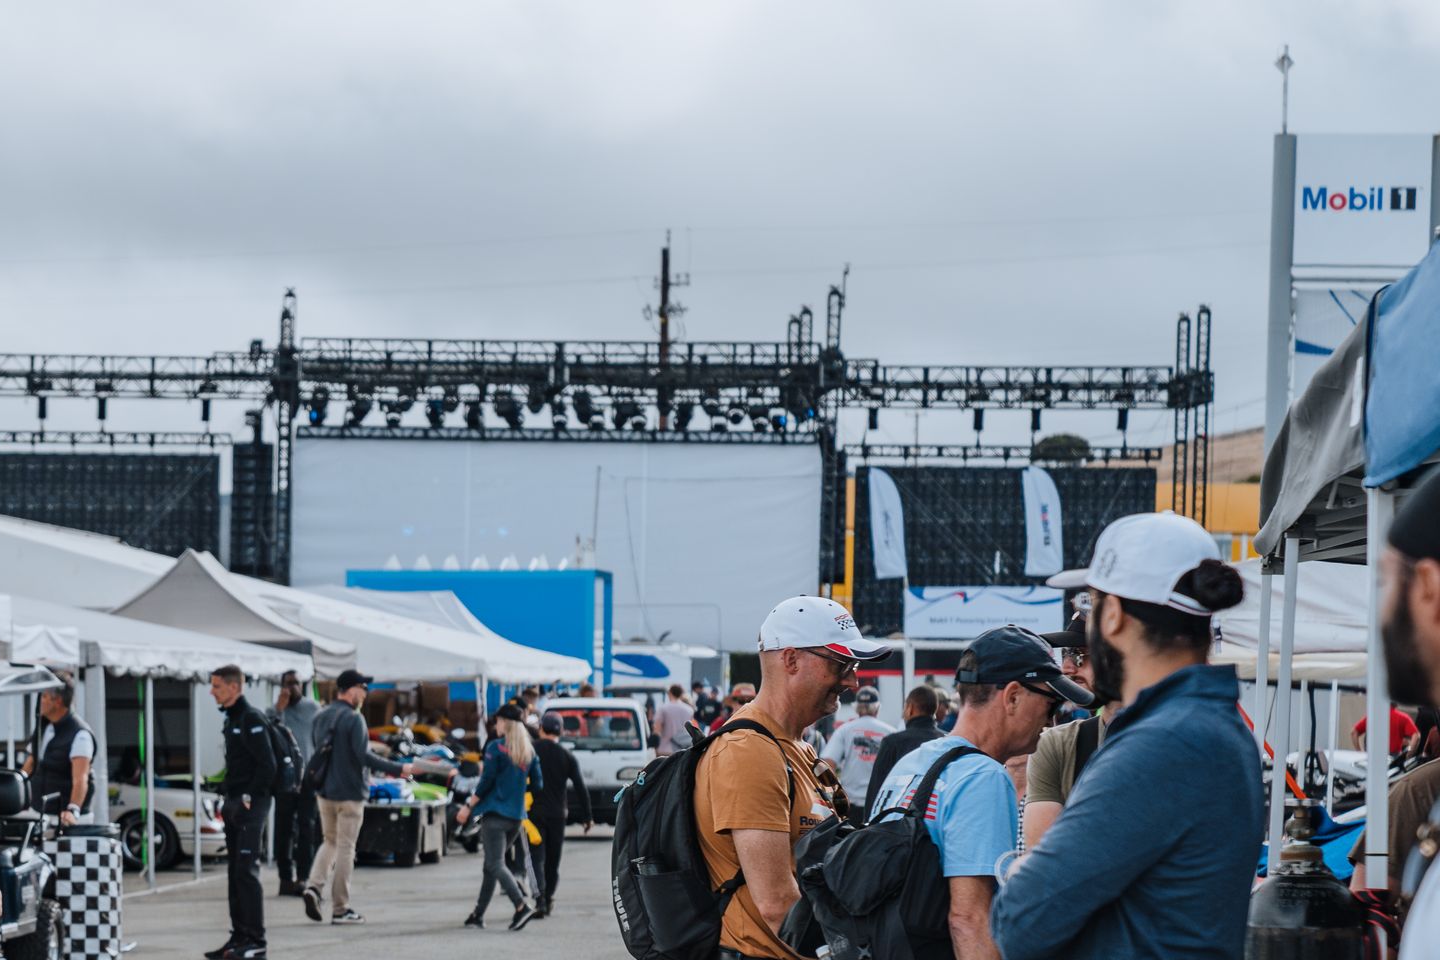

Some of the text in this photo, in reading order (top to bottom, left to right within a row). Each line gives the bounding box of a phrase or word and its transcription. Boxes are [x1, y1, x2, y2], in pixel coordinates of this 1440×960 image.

[1302, 186, 1417, 211] Mobil 1
[612, 875, 630, 933] THULE
